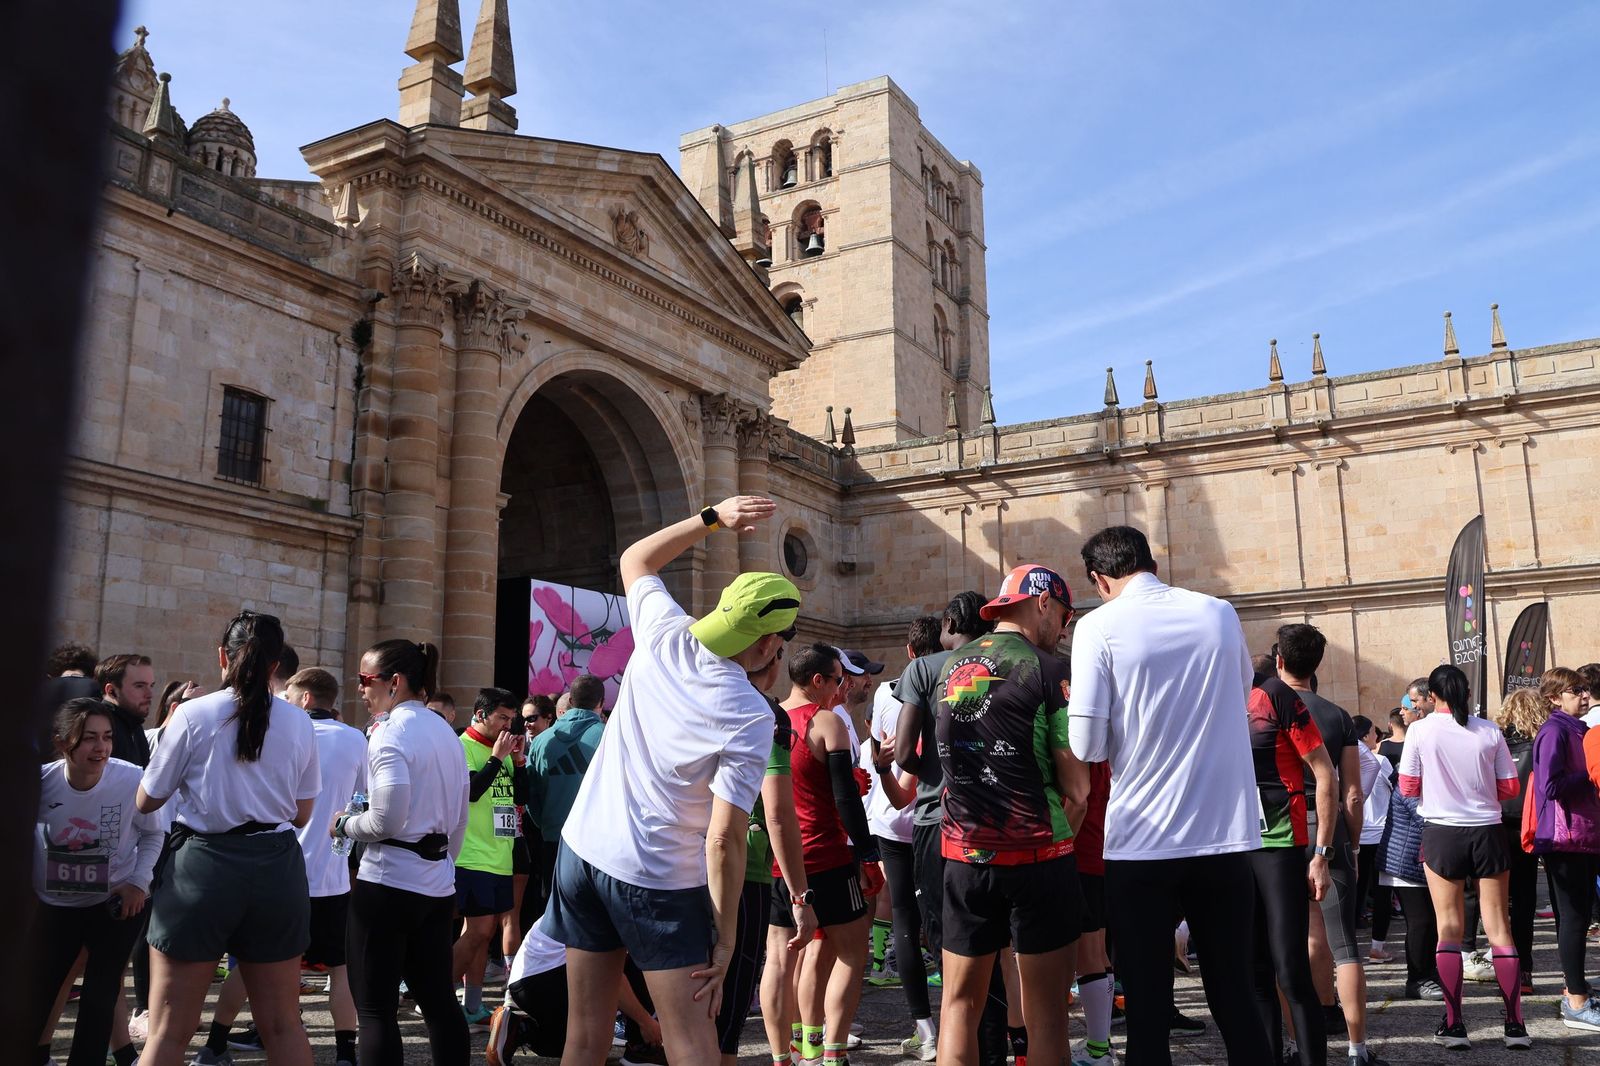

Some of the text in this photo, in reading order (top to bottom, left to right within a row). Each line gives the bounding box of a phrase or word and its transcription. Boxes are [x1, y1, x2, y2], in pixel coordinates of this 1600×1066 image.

[1028, 572, 1051, 582] RUN
[979, 656, 997, 673] TRAIL
[57, 863, 97, 883] 616
